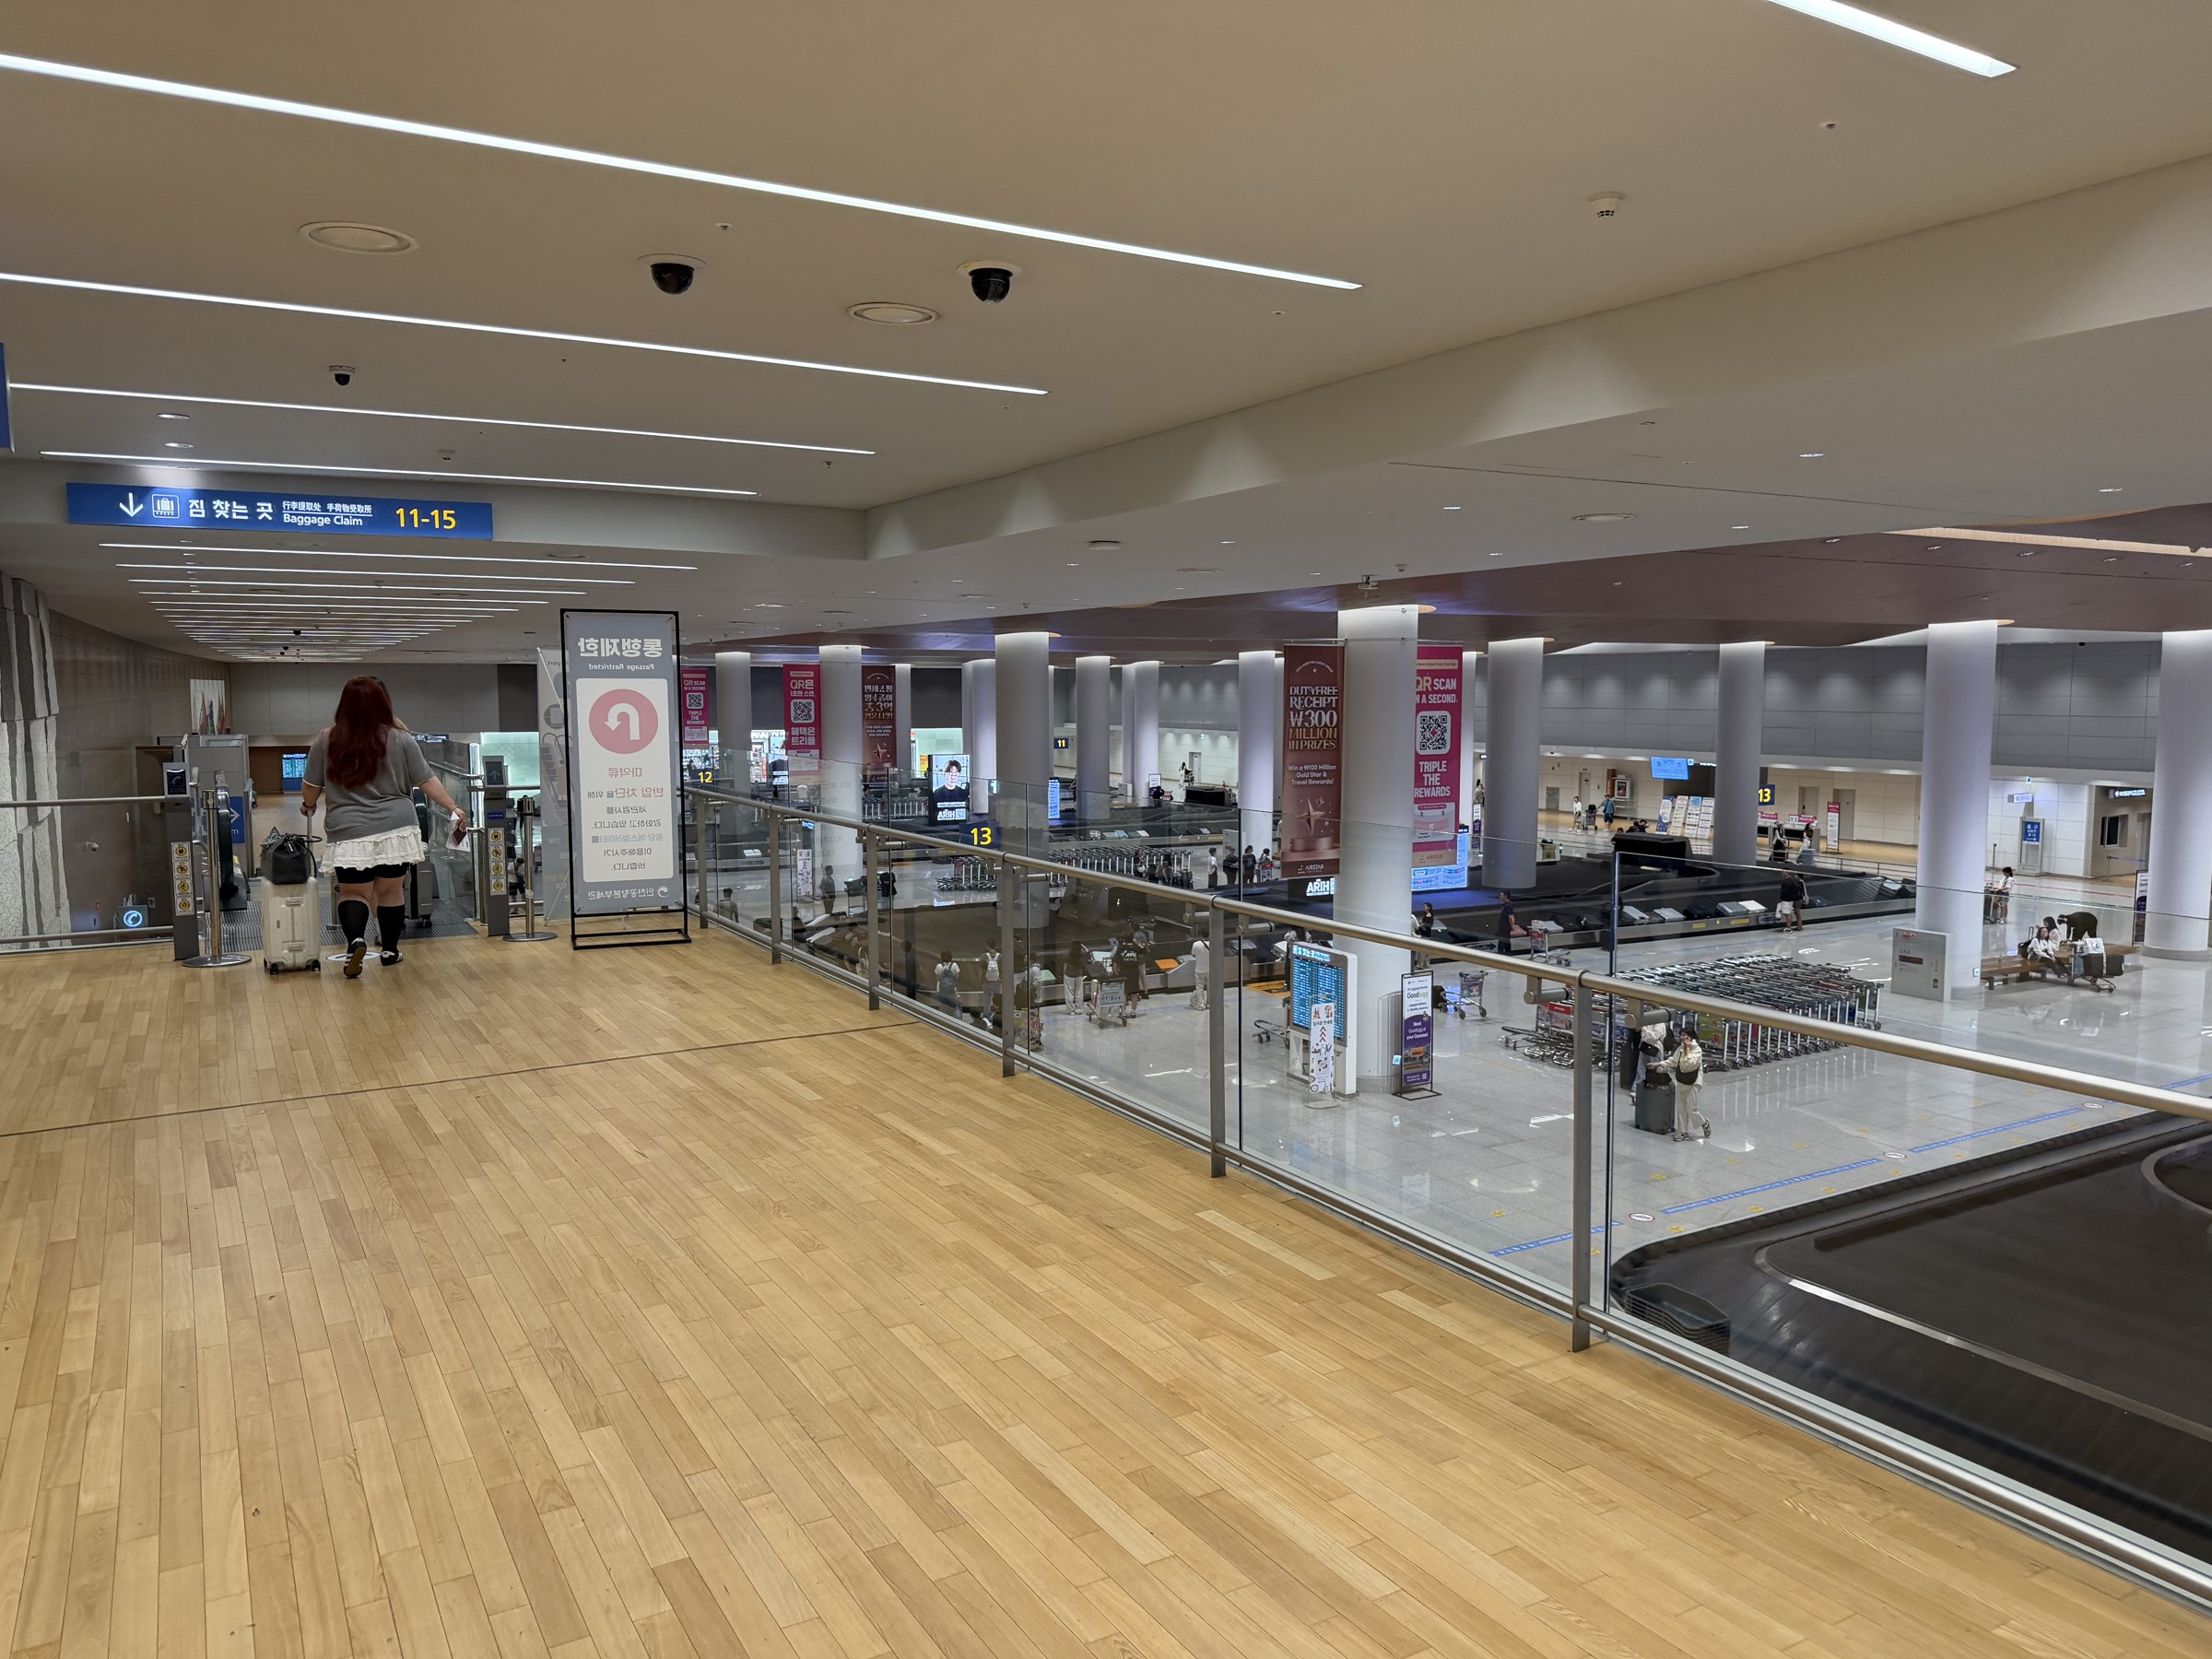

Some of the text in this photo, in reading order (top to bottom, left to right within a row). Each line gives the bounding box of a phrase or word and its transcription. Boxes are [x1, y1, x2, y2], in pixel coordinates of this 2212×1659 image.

[189, 500, 274, 521] 짐 찾는 곳
[282, 500, 322, 512] 行李提取处
[326, 503, 372, 514] 手荷物受取所
[283, 513, 363, 526] Baggage Claim
[395, 507, 457, 530] 11-15
[790, 679, 814, 689] QR은
[1433, 677, 1457, 690] SCAN
[1289, 686, 1338, 696] DUTYFREE
[1289, 696, 1338, 709] RECEIPT
[1421, 695, 1428, 704] A
[1429, 693, 1458, 704] SECOND.
[1288, 727, 1337, 739] MILLION
[1057, 739, 1066, 747] 11
[1418, 760, 1447, 773] TRIPLE
[698, 771, 712, 783] 12
[1423, 772, 1441, 786] THE
[1414, 785, 1451, 798] REWARDS
[1759, 788, 1771, 803] 13
[971, 827, 992, 846] 13
